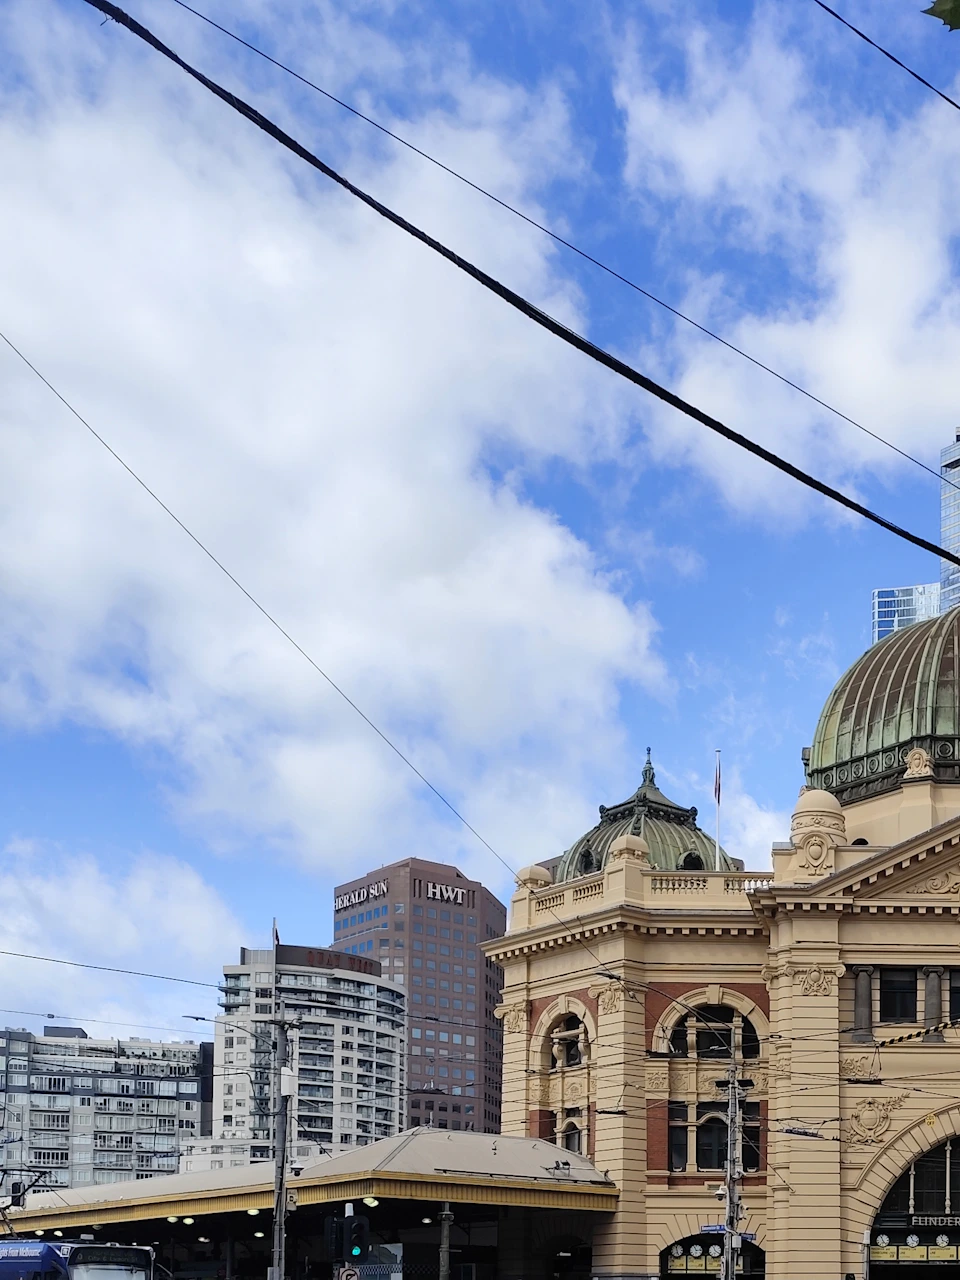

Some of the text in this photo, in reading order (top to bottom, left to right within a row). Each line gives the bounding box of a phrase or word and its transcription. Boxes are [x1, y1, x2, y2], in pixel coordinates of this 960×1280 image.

[334, 880, 389, 911] HERALD SUN
[427, 882, 467, 905] HWT
[307, 951, 341, 967] QUAY
